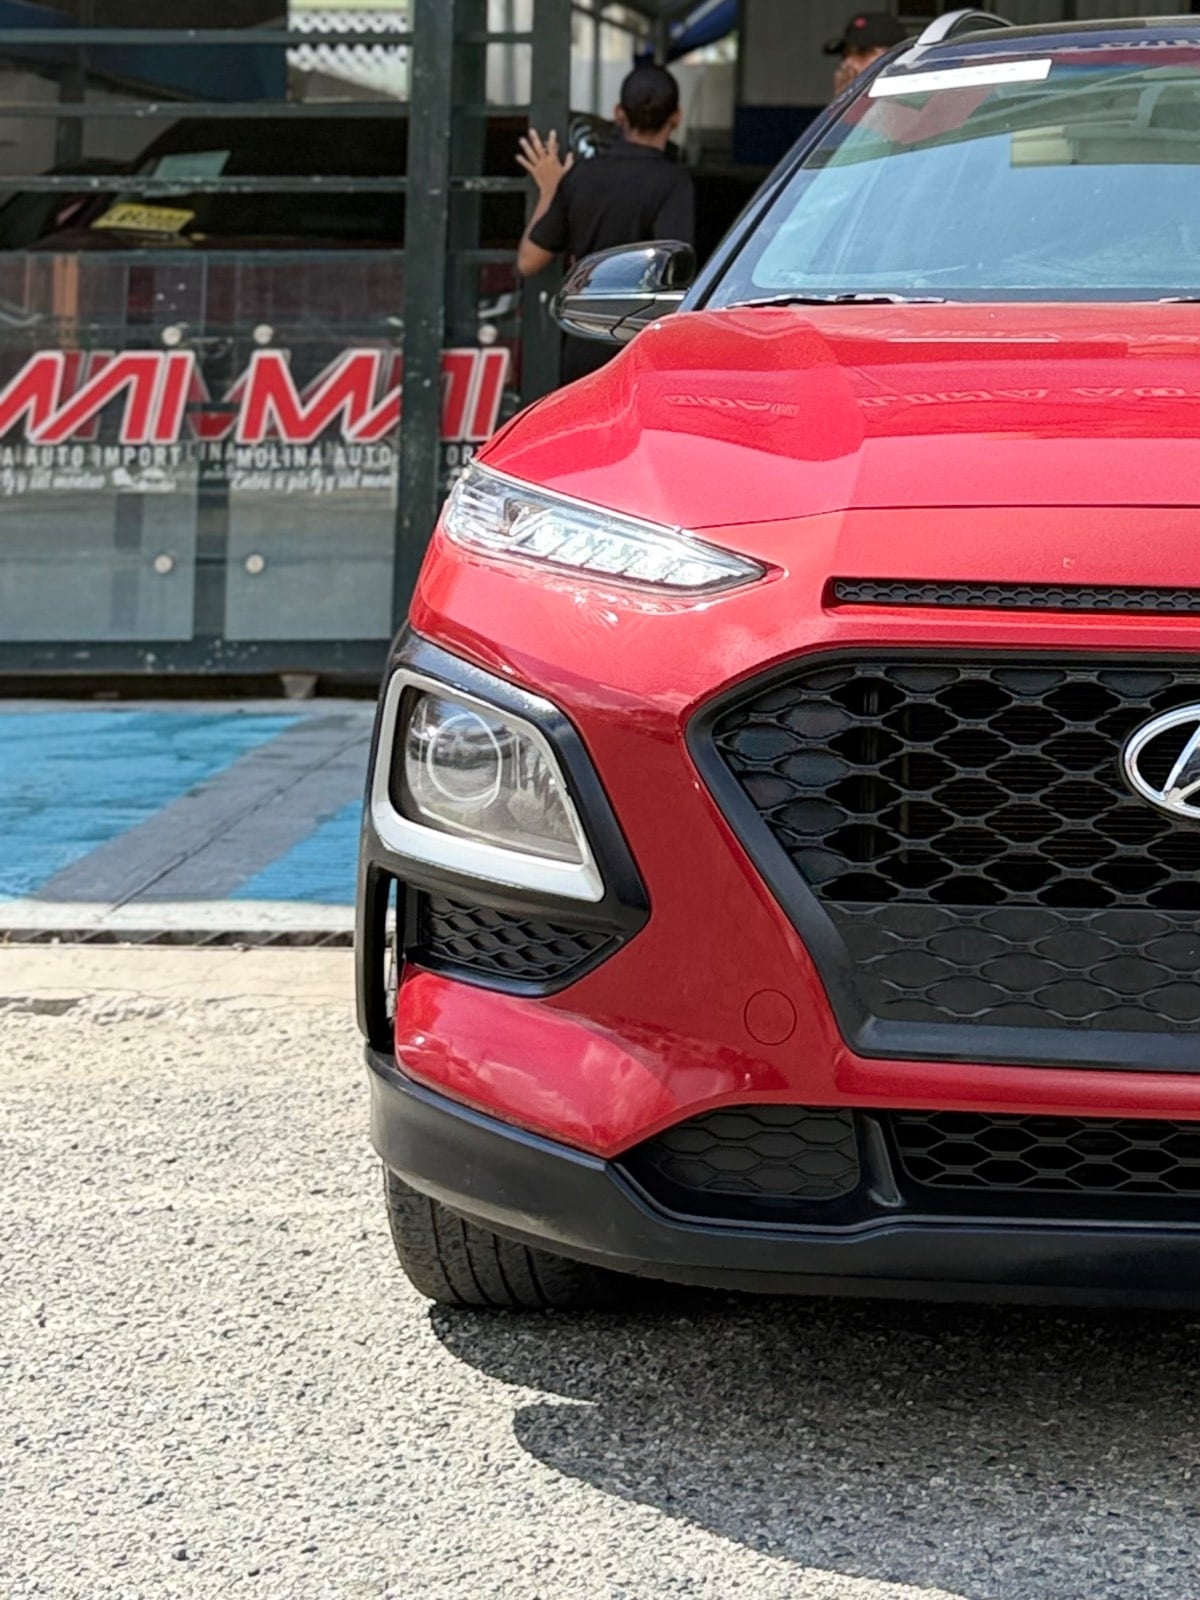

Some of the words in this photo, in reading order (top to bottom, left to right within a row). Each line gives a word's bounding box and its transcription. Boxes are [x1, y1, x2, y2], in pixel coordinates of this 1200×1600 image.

[25, 446, 84, 468] AUTO
[236, 446, 322, 468] MOLINA
[334, 445, 391, 467] AUTO
